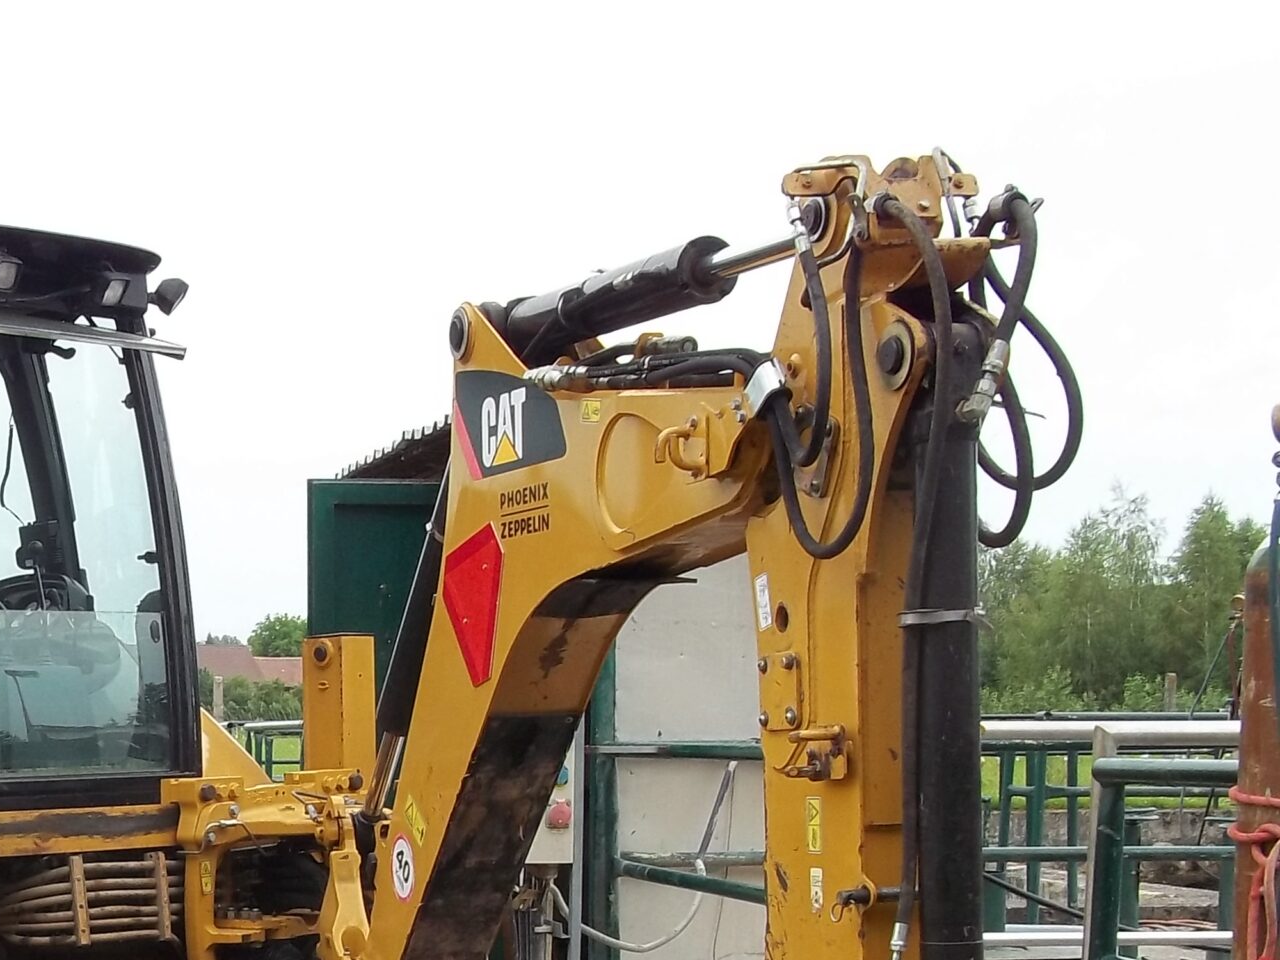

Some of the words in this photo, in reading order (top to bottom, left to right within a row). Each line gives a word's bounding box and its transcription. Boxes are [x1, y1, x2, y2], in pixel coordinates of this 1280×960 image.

[481, 386, 527, 468] CAT
[500, 482, 549, 510] PHOENIX
[500, 513, 550, 539] ZEPPELIN
